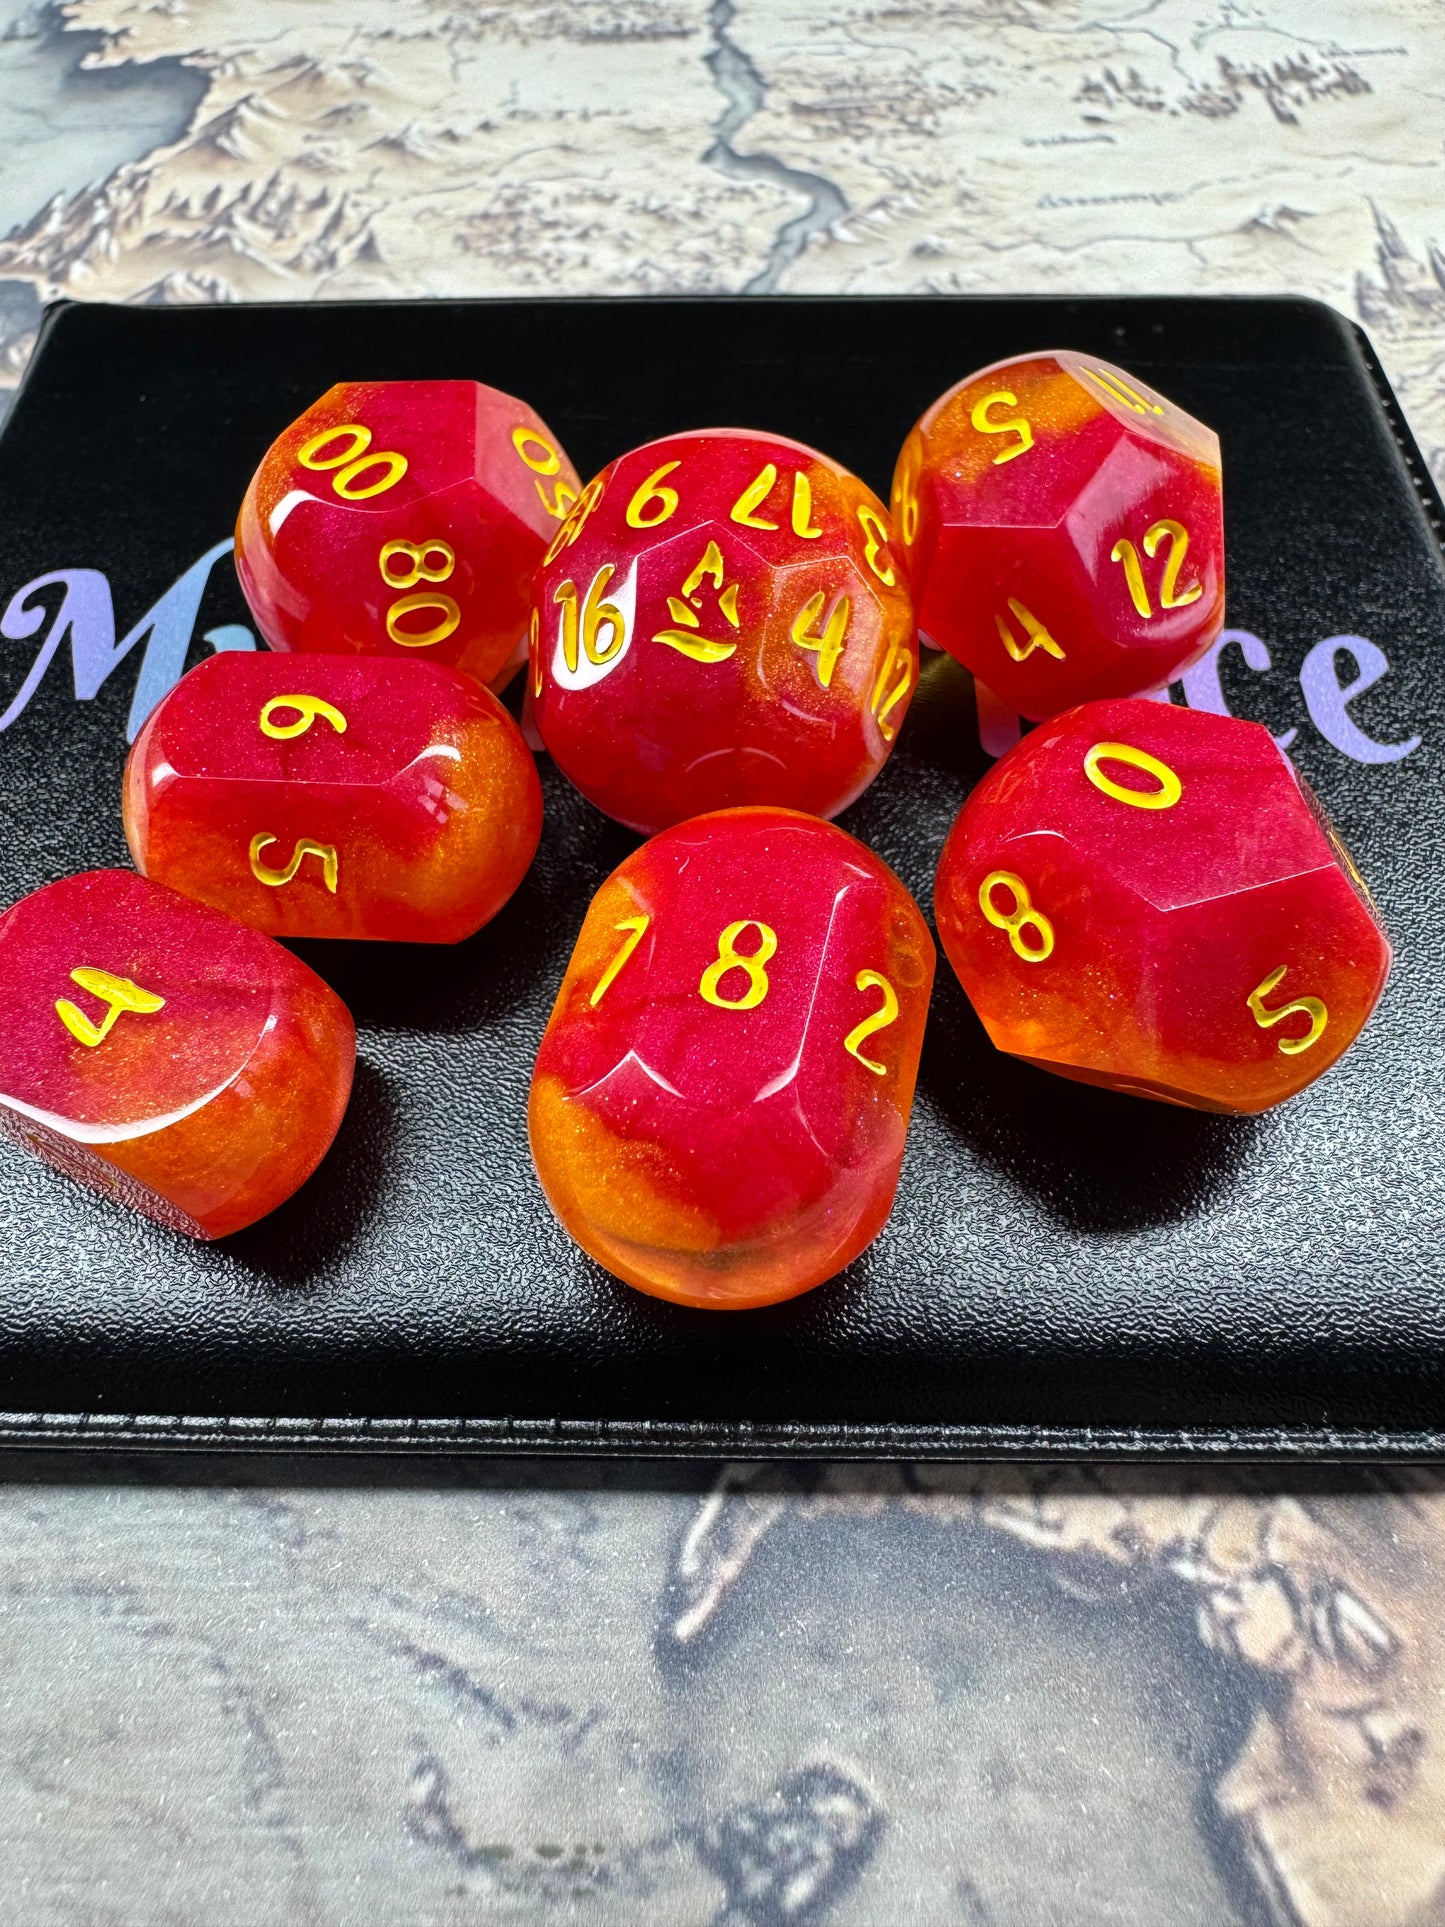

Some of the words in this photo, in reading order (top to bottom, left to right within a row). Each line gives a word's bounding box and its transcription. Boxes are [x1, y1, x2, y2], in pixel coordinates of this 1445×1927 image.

[297, 424, 408, 500] 00
[970, 391, 1035, 465] 5
[378, 538, 461, 647] 80
[1110, 518, 1203, 619] 12
[553, 563, 626, 673] 16
[792, 591, 849, 688] 4
[994, 597, 1066, 662] 4
[1084, 741, 1182, 810] 0
[249, 831, 338, 894] 5
[979, 869, 1054, 962] 8
[55, 966, 166, 1047] 4
[699, 920, 778, 1010] 8
[1246, 964, 1328, 1054] 5
[844, 969, 899, 1076] 2
